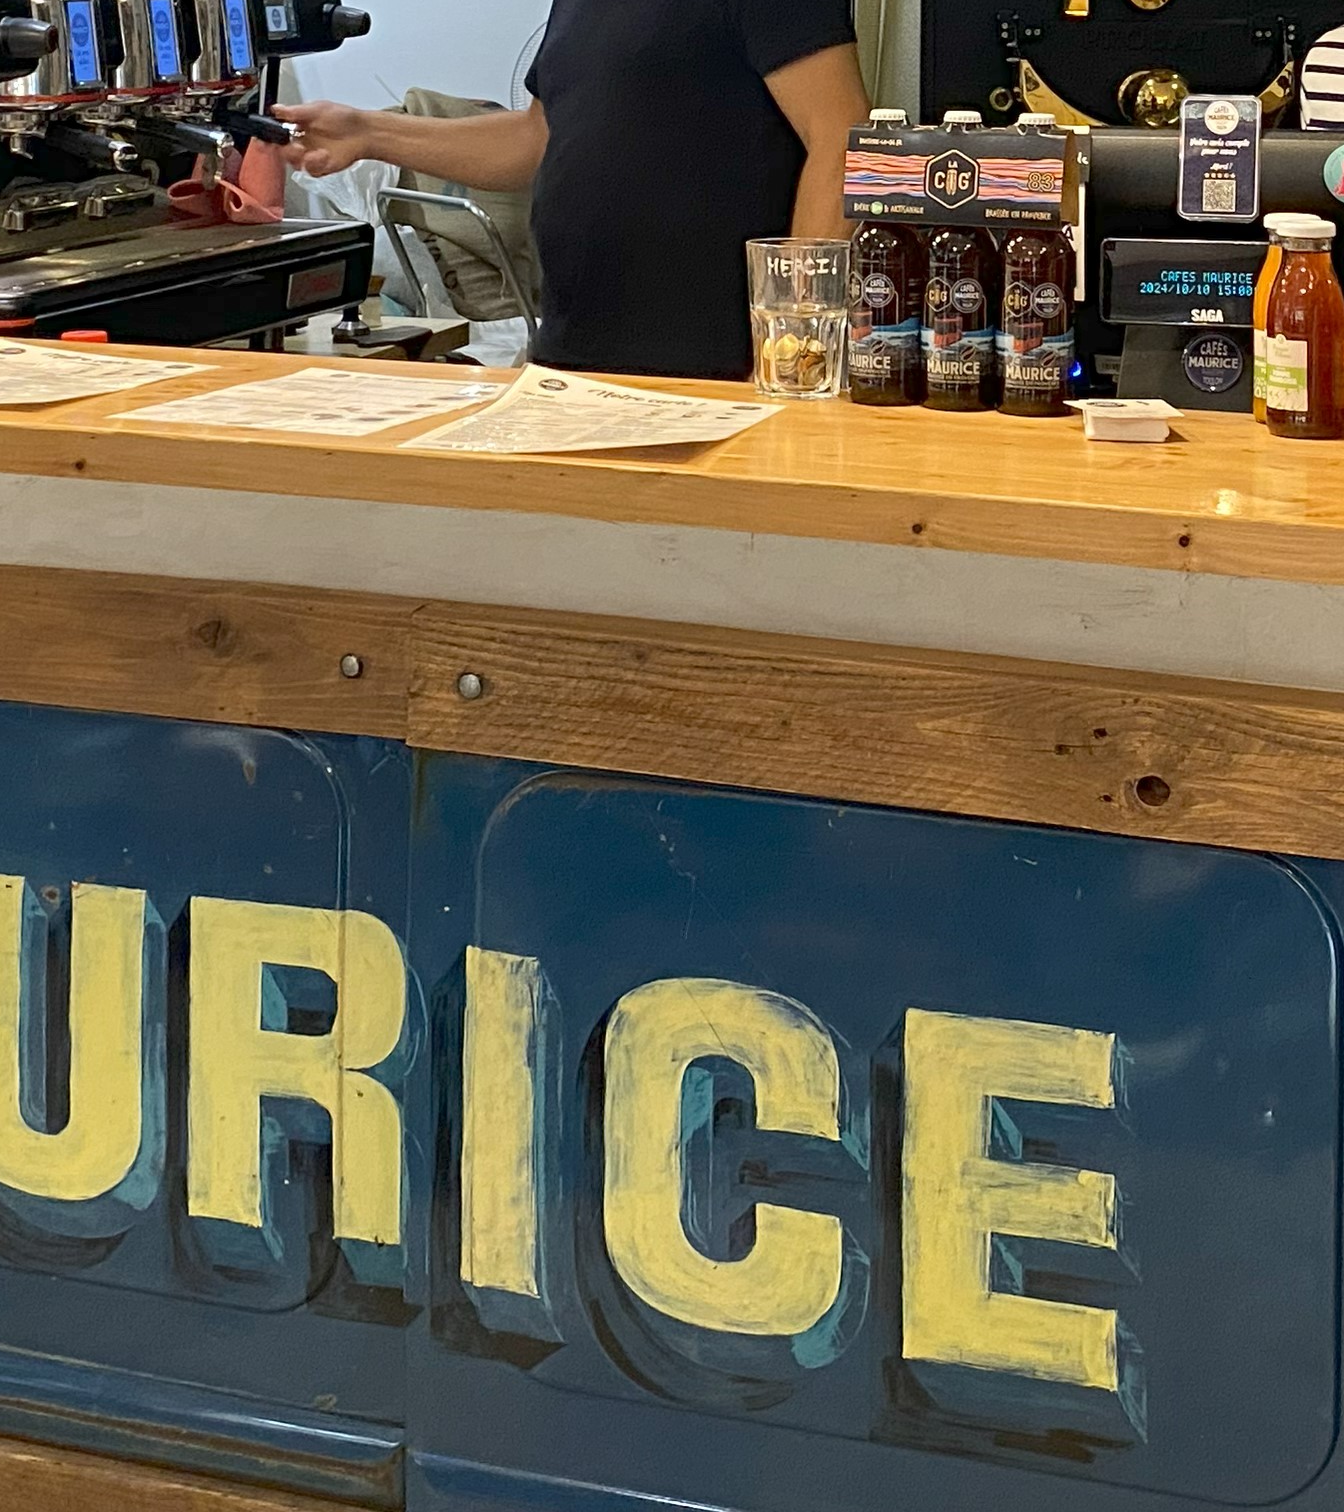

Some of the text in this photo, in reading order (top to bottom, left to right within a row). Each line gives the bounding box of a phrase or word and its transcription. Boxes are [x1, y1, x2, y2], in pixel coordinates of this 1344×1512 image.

[947, 160, 958, 168] LA
[1027, 171, 1056, 193] 83
[1160, 270, 1254, 284] CAFES MAURICE
[1190, 308, 1225, 324] SAGA
[1199, 338, 1229, 356] CAFÉS
[927, 360, 981, 376] MAURICE
[1188, 356, 1239, 370] MAURICE
[1006, 366, 1061, 381] MAURICE
